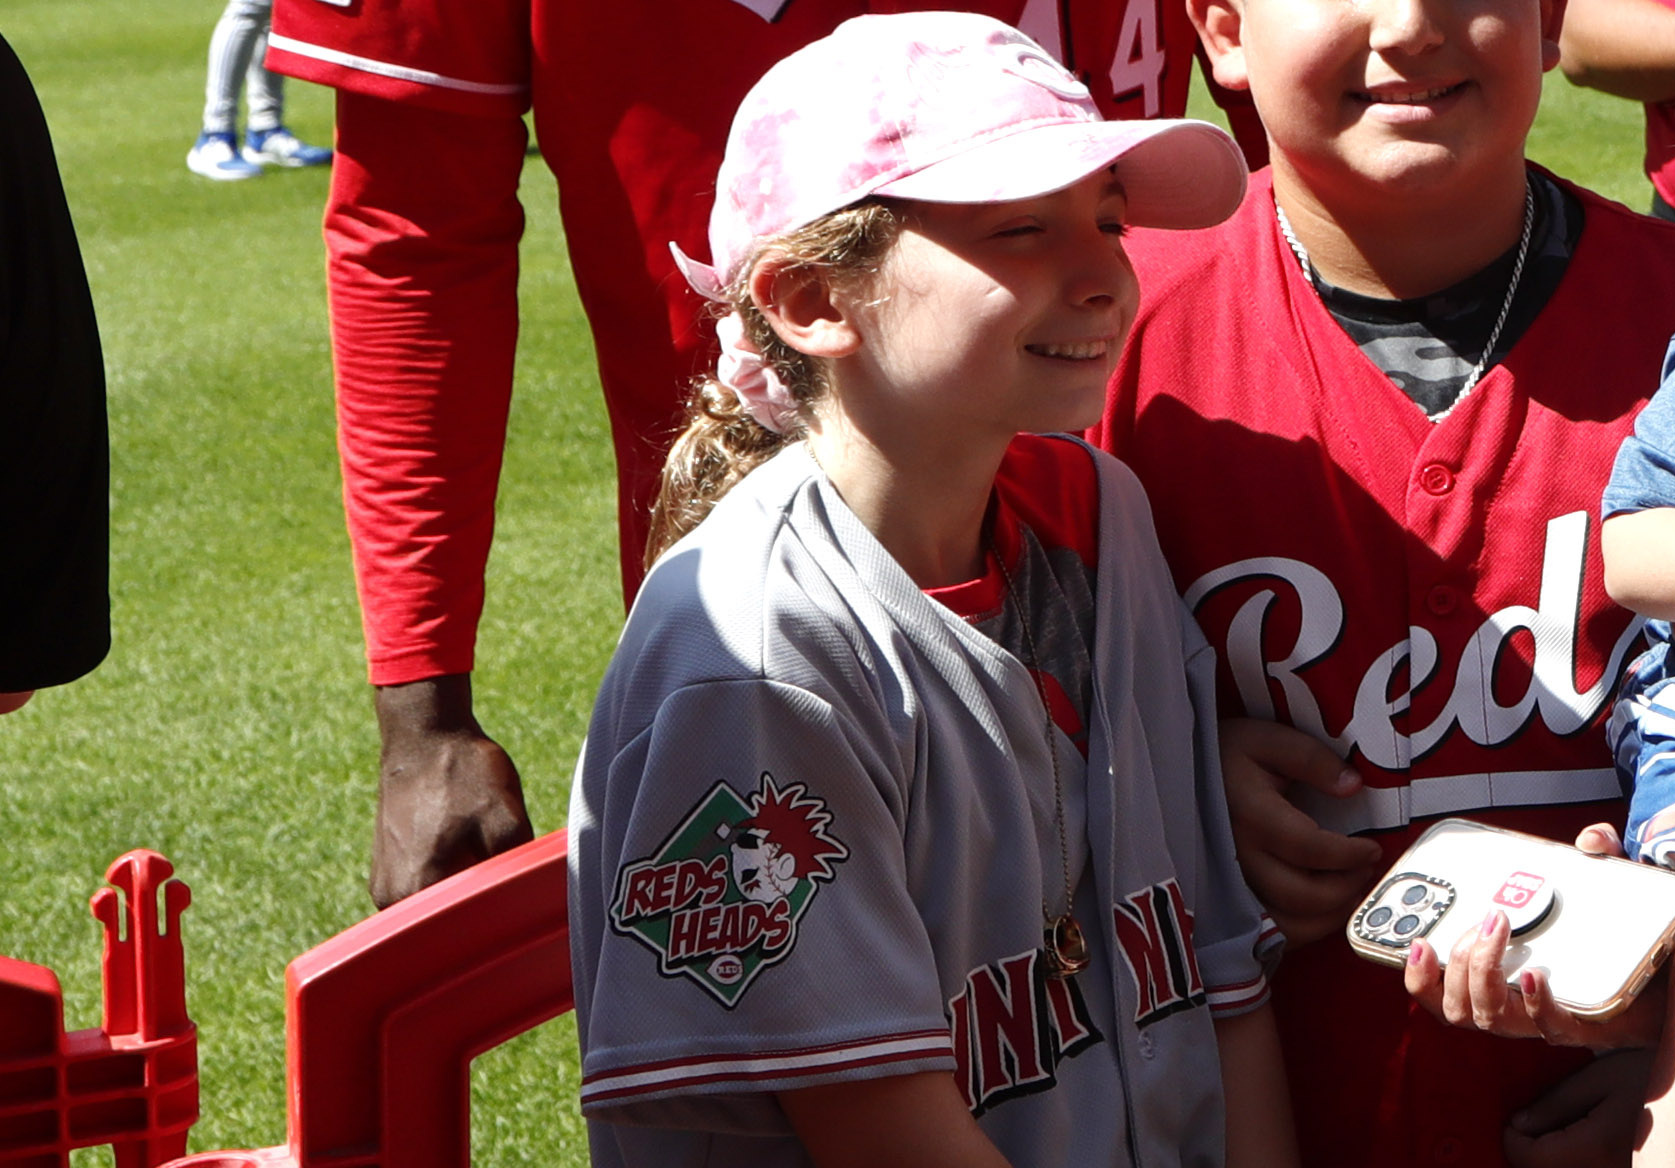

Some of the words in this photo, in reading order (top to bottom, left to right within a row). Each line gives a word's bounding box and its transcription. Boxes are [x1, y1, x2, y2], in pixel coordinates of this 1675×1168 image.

[1183, 509, 1646, 770] Red
[620, 852, 729, 922] REDS
[667, 897, 792, 962] HEADS
